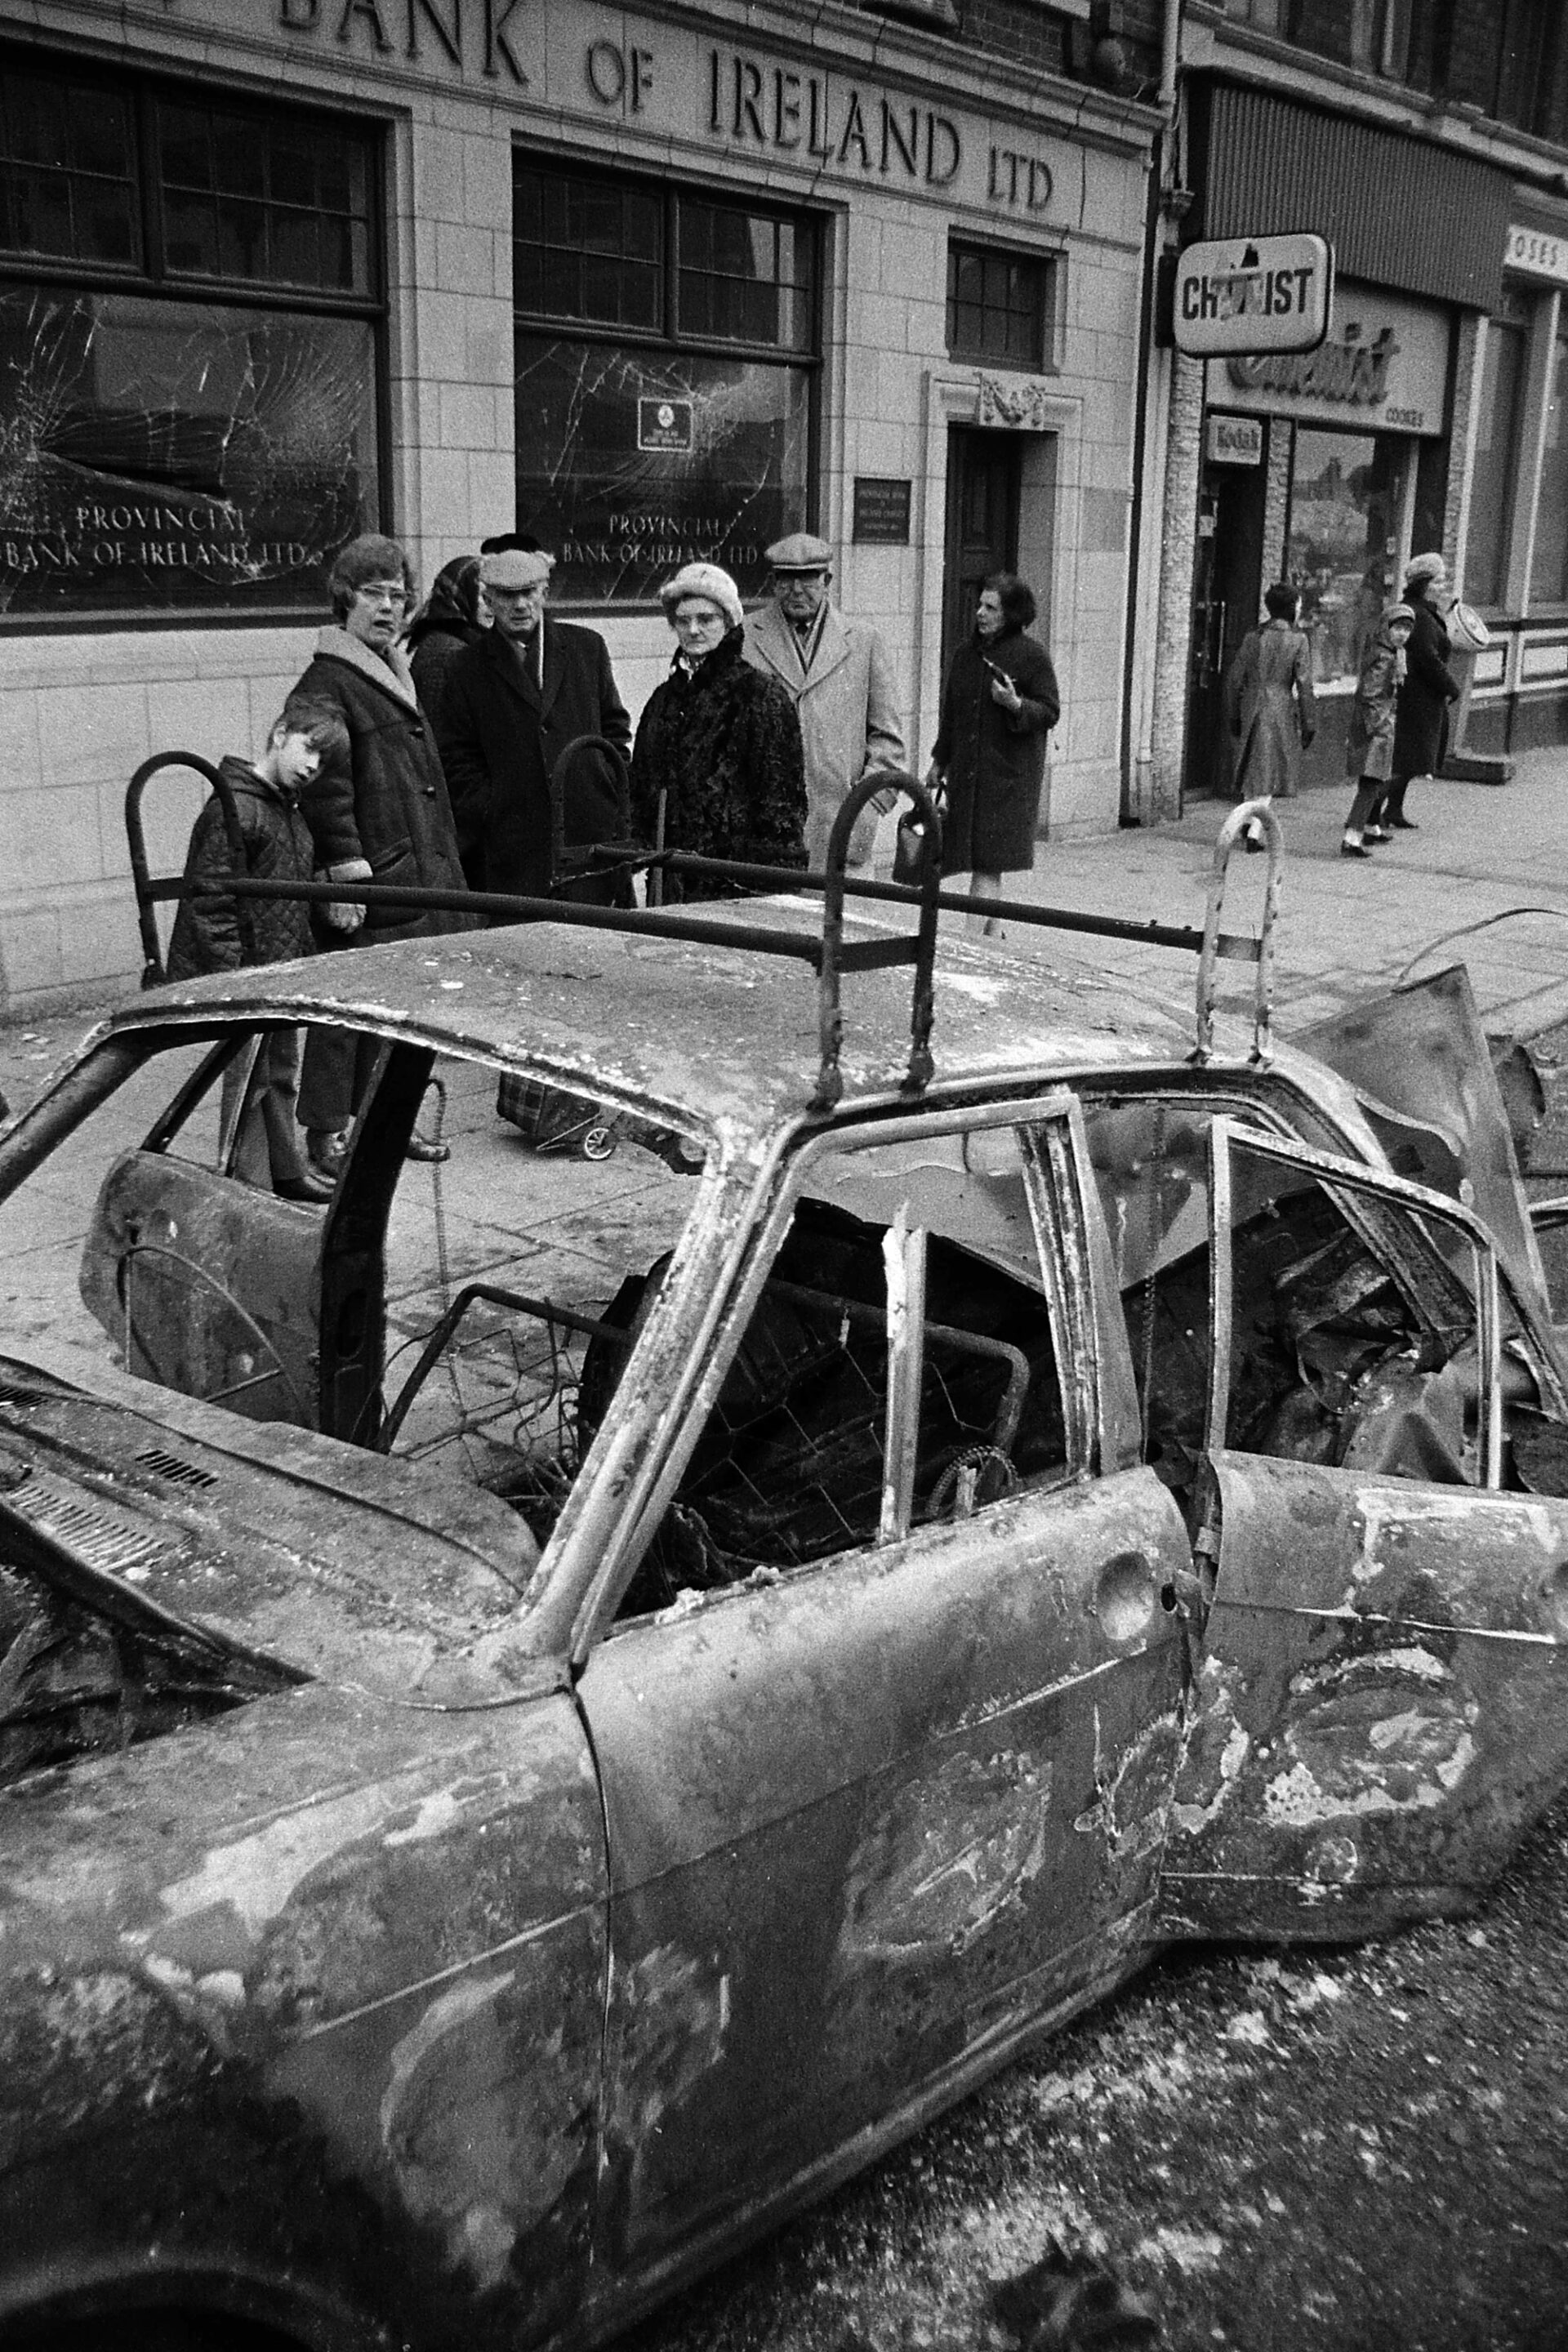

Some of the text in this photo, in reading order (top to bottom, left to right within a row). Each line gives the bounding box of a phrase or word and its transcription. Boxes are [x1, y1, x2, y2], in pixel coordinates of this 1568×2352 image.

[586, 41, 653, 113] OF
[705, 49, 960, 187] IRELAND
[987, 146, 1053, 212] LTD
[1182, 268, 1313, 320] CHIST
[77, 506, 249, 531] PROVINCIAL
[610, 514, 722, 537] PROVINCIAL
[6, 541, 306, 567] BANK OF IRELAND LTD
[564, 542, 611, 564] BANK
[620, 543, 641, 564] OF
